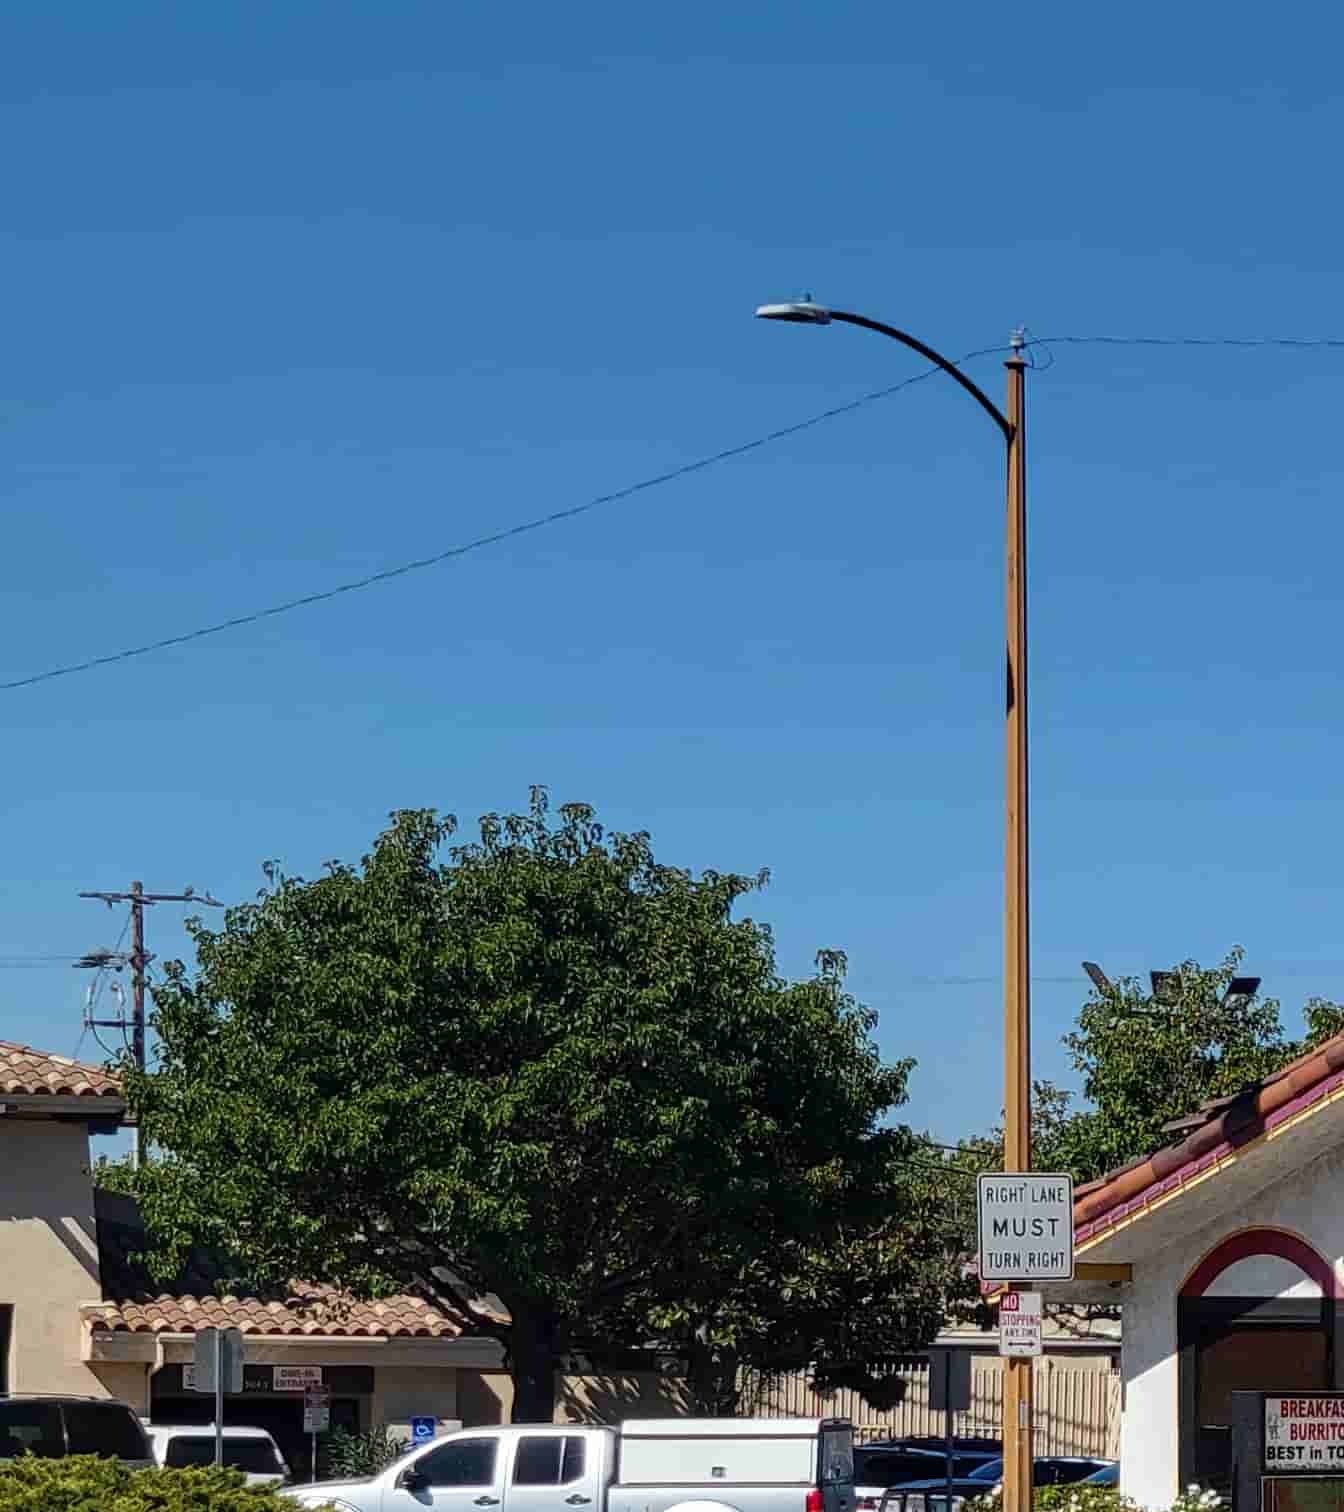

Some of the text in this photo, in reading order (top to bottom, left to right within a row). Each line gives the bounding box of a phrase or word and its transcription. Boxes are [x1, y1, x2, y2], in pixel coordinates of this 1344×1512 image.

[986, 1187, 1065, 1203] RIGHT LANE
[992, 1218, 1059, 1237] MUST
[987, 1252, 1065, 1269] TURN RIGHT
[1001, 1294, 1017, 1309] NO
[1001, 1314, 1040, 1326] STOPPING
[1267, 1446, 1304, 1460] BEST
[1310, 1446, 1322, 1459] in
